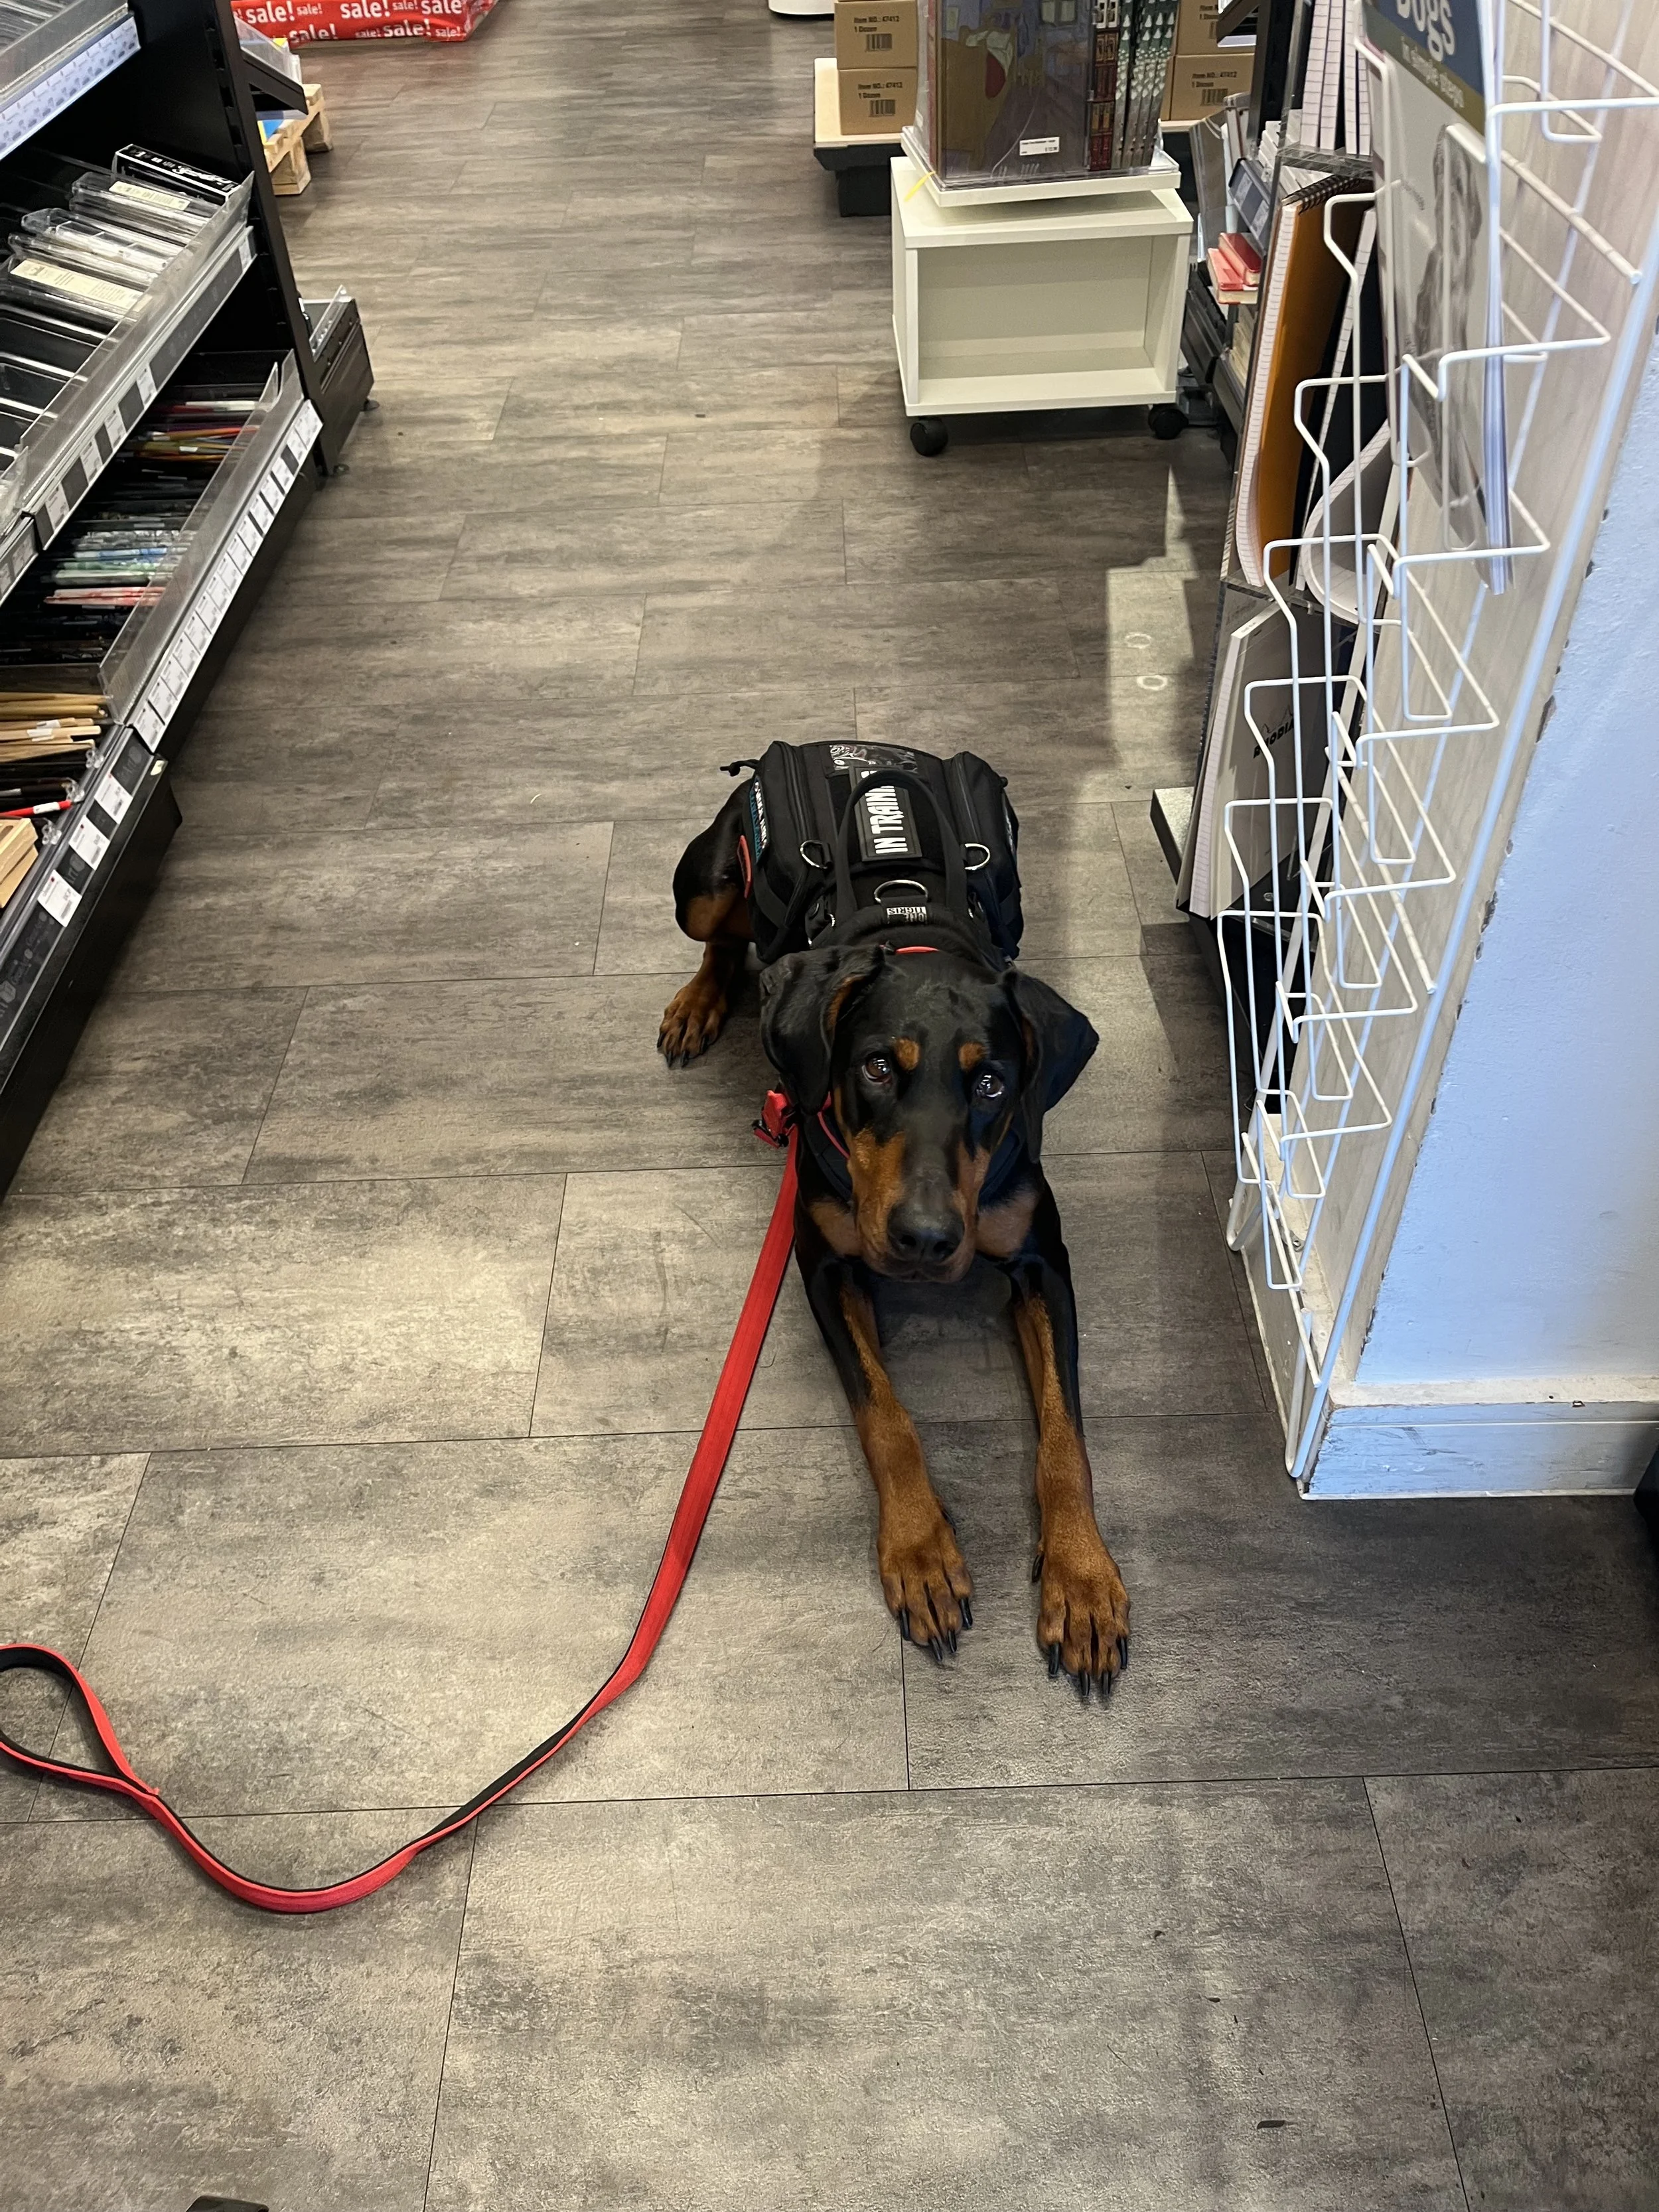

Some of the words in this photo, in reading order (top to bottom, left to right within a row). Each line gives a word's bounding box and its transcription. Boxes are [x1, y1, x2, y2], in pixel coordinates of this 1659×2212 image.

[246, 1, 295, 24] sale!
[297, 3, 323, 16] sale!
[340, 0, 390, 19] sale!
[392, 1, 418, 11] sale!
[289, 23, 338, 42] sale!
[383, 19, 432, 37] sale!
[435, 26, 461, 37] sale!
[861, 771, 904, 834] TRAINI
[873, 837, 908, 854] IN
